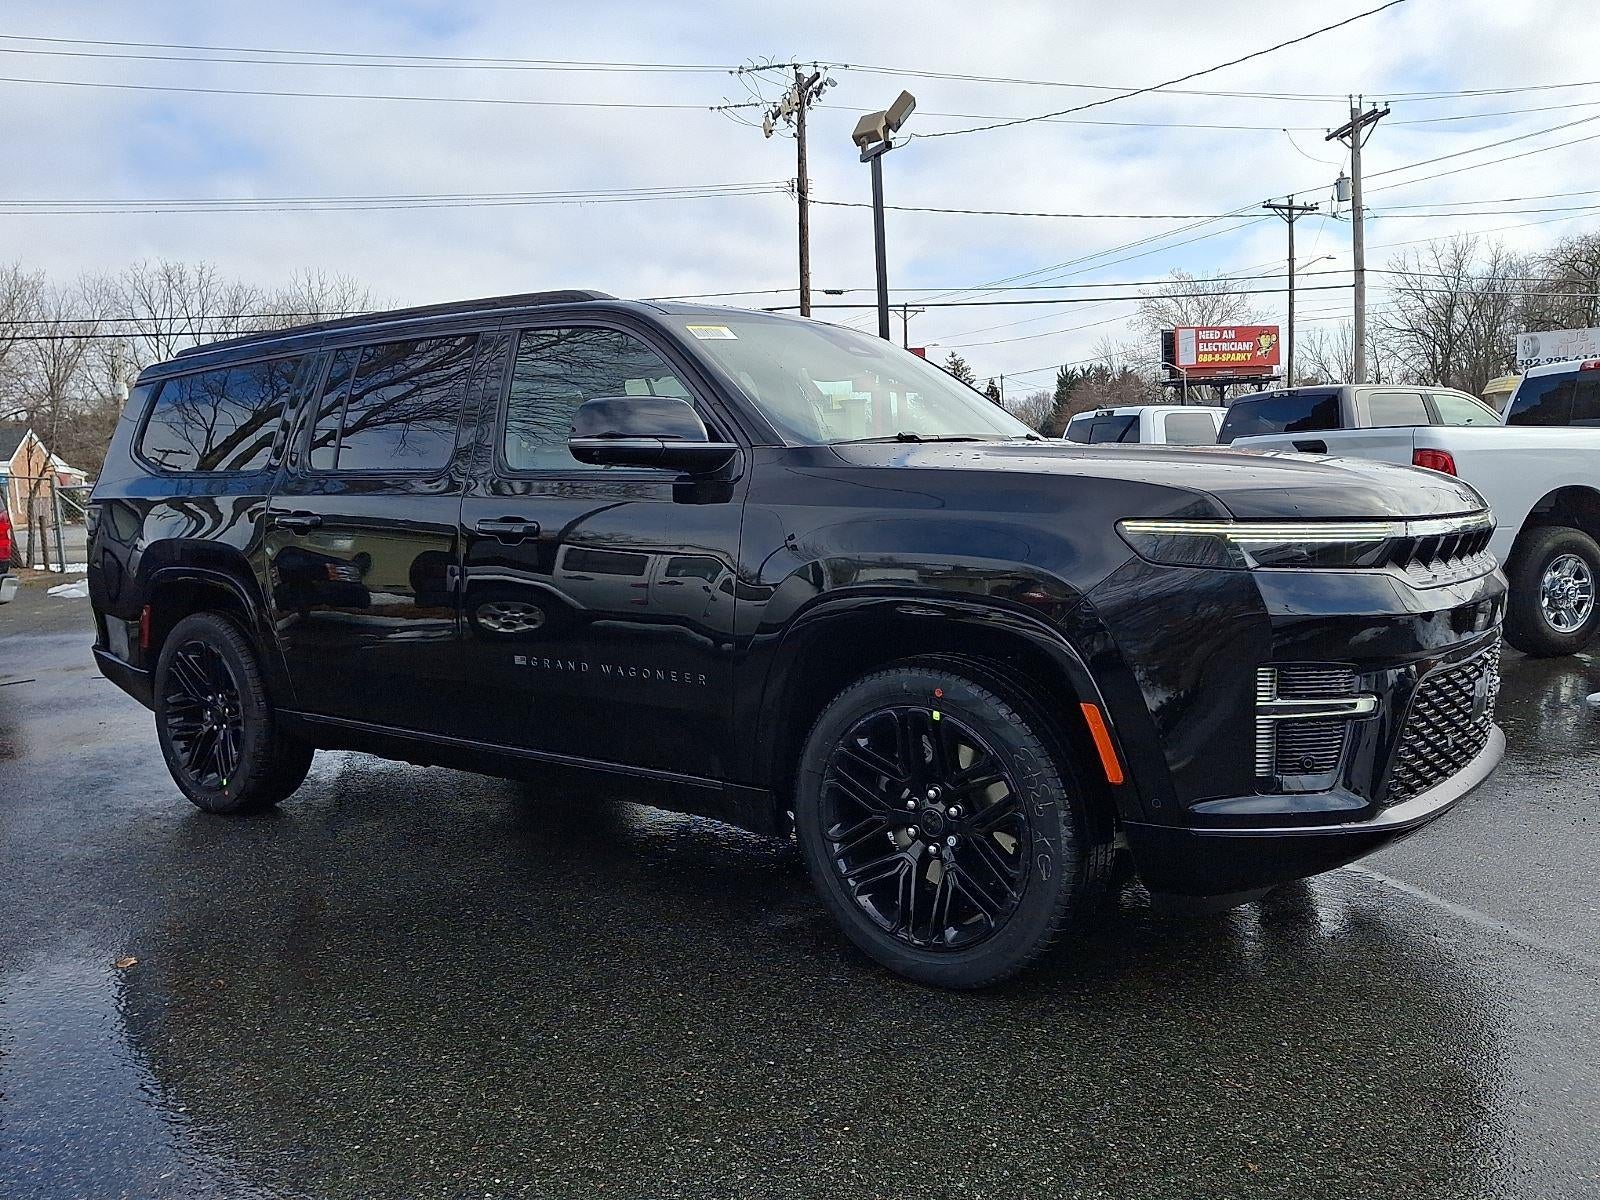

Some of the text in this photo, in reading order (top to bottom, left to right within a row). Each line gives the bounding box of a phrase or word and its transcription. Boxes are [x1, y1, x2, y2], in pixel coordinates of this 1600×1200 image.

[1198, 329, 1236, 340] NEED AN
[1198, 341, 1254, 352] ELECTRICIAN?
[1198, 352, 1253, 363] 888-8-SPARKY
[530, 656, 707, 686] GRAND WAGONEER
